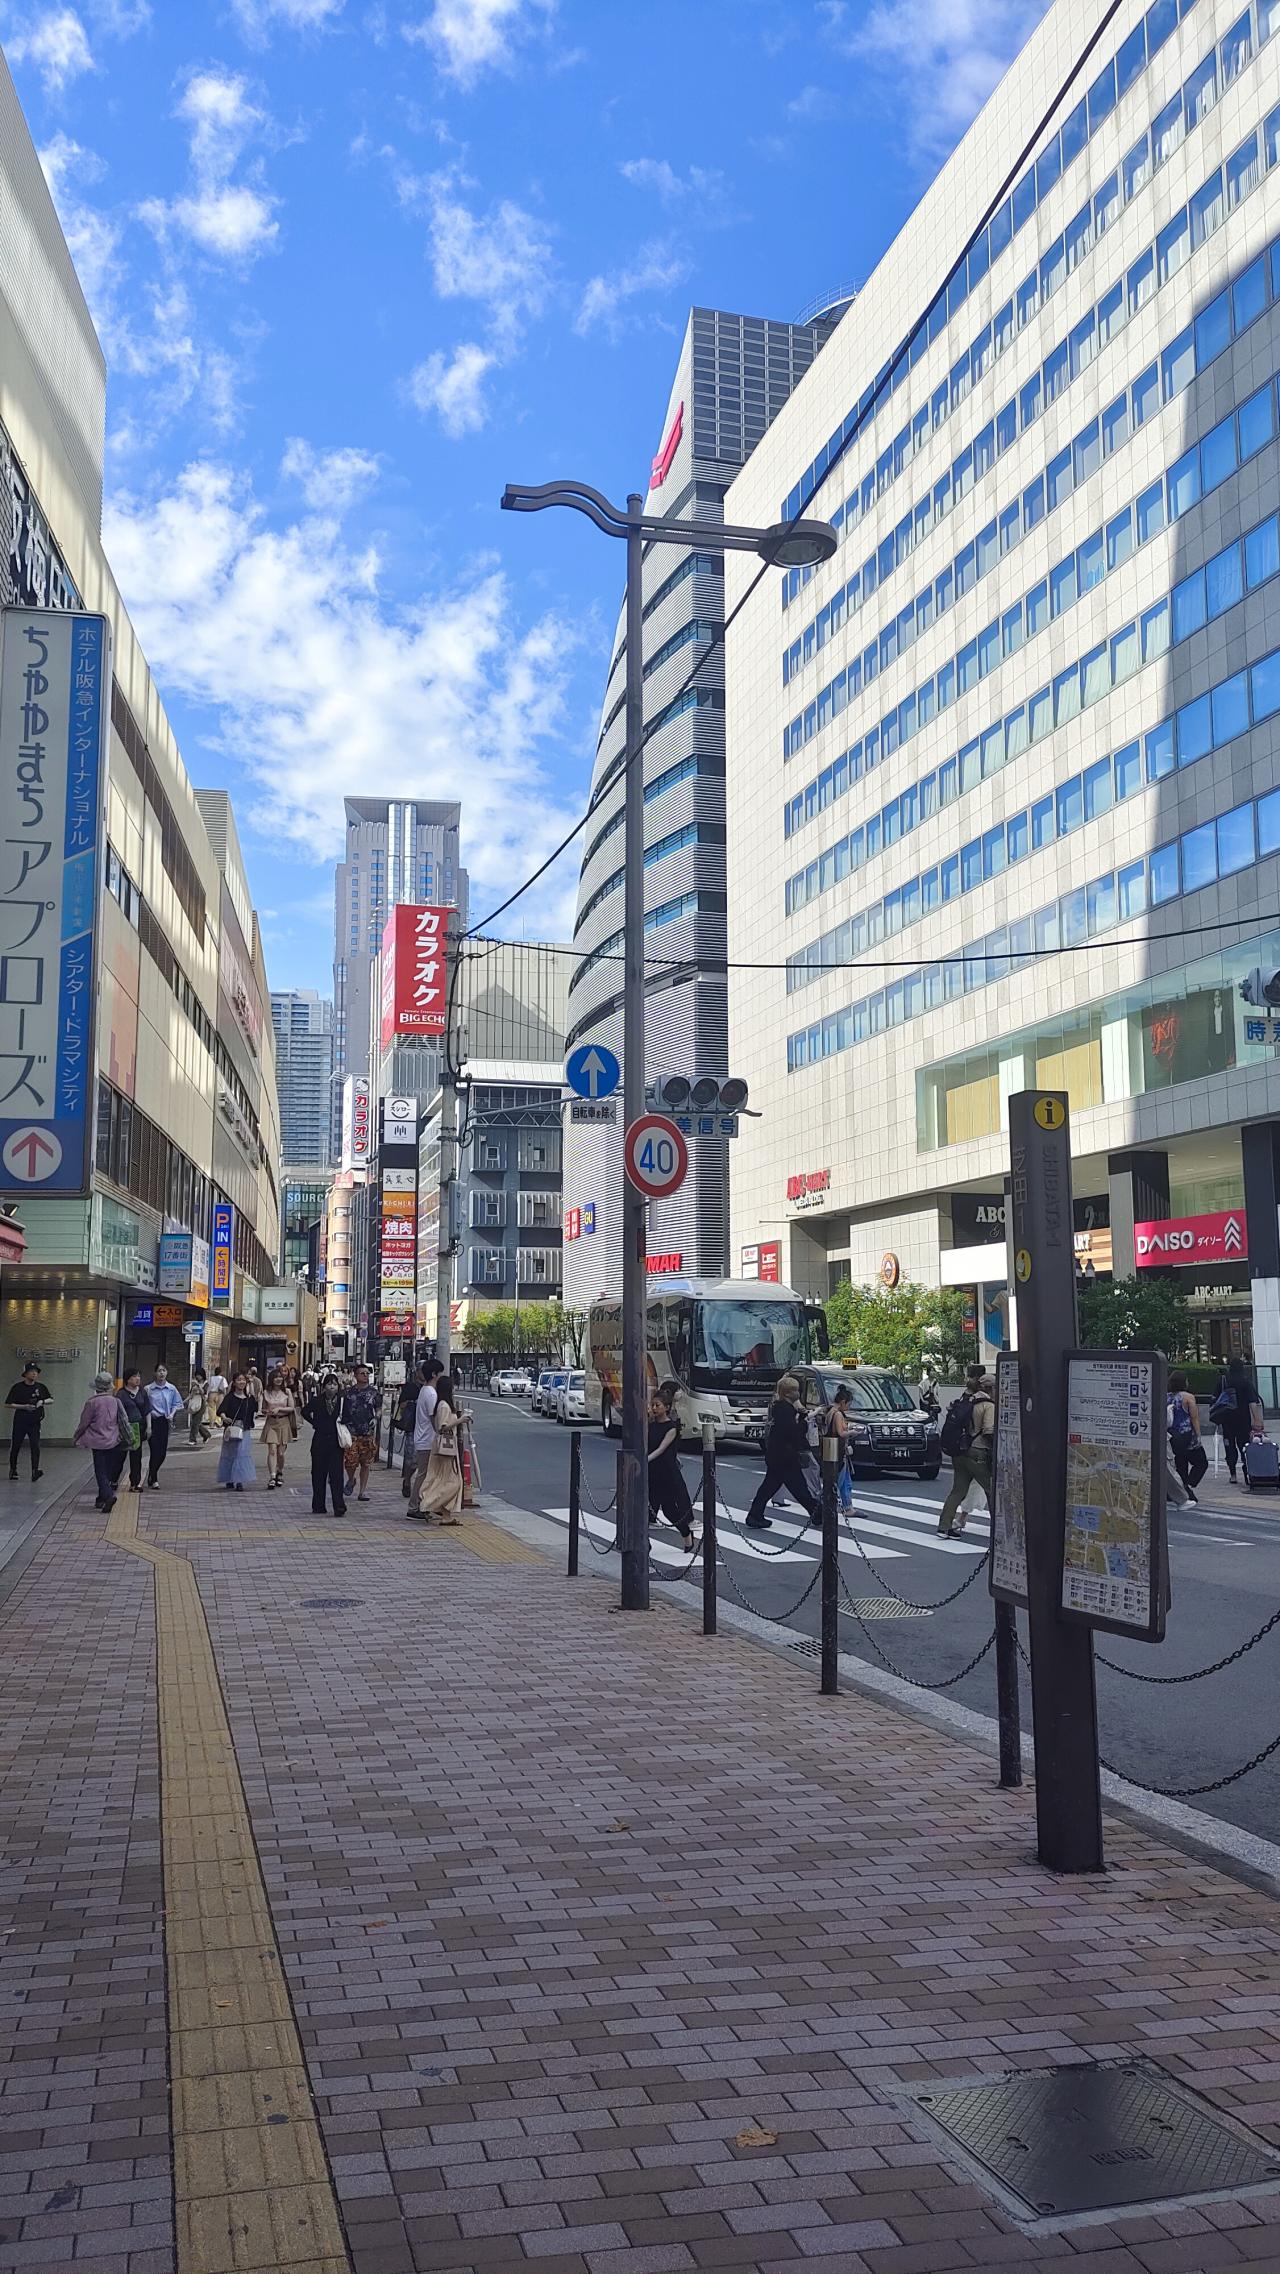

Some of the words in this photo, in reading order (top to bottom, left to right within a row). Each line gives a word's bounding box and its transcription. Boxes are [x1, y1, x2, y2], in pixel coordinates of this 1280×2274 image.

[70, 626, 97, 846] ホテル阪急インターナショナル
[413, 912, 440, 1006] カラオケ
[399, 1012, 420, 1024] BIG
[61, 949, 84, 1112] シアター・ドラマシティ
[572, 1105, 615, 1119] 自転車を除く
[354, 1094, 368, 1153] カラオケ
[640, 1138, 674, 1175] 40
[216, 1213, 229, 1229] P
[584, 1211, 593, 1225] GU
[384, 1220, 413, 1235] 焼肉
[217, 1231, 229, 1243] IN
[1137, 1230, 1194, 1255] DAISO
[1197, 1236, 1223, 1247] ダイソー
[646, 1253, 681, 1273] MAR
[1194, 1285, 1233, 1299] ABC-MART
[383, 1315, 411, 1323] カラケ
